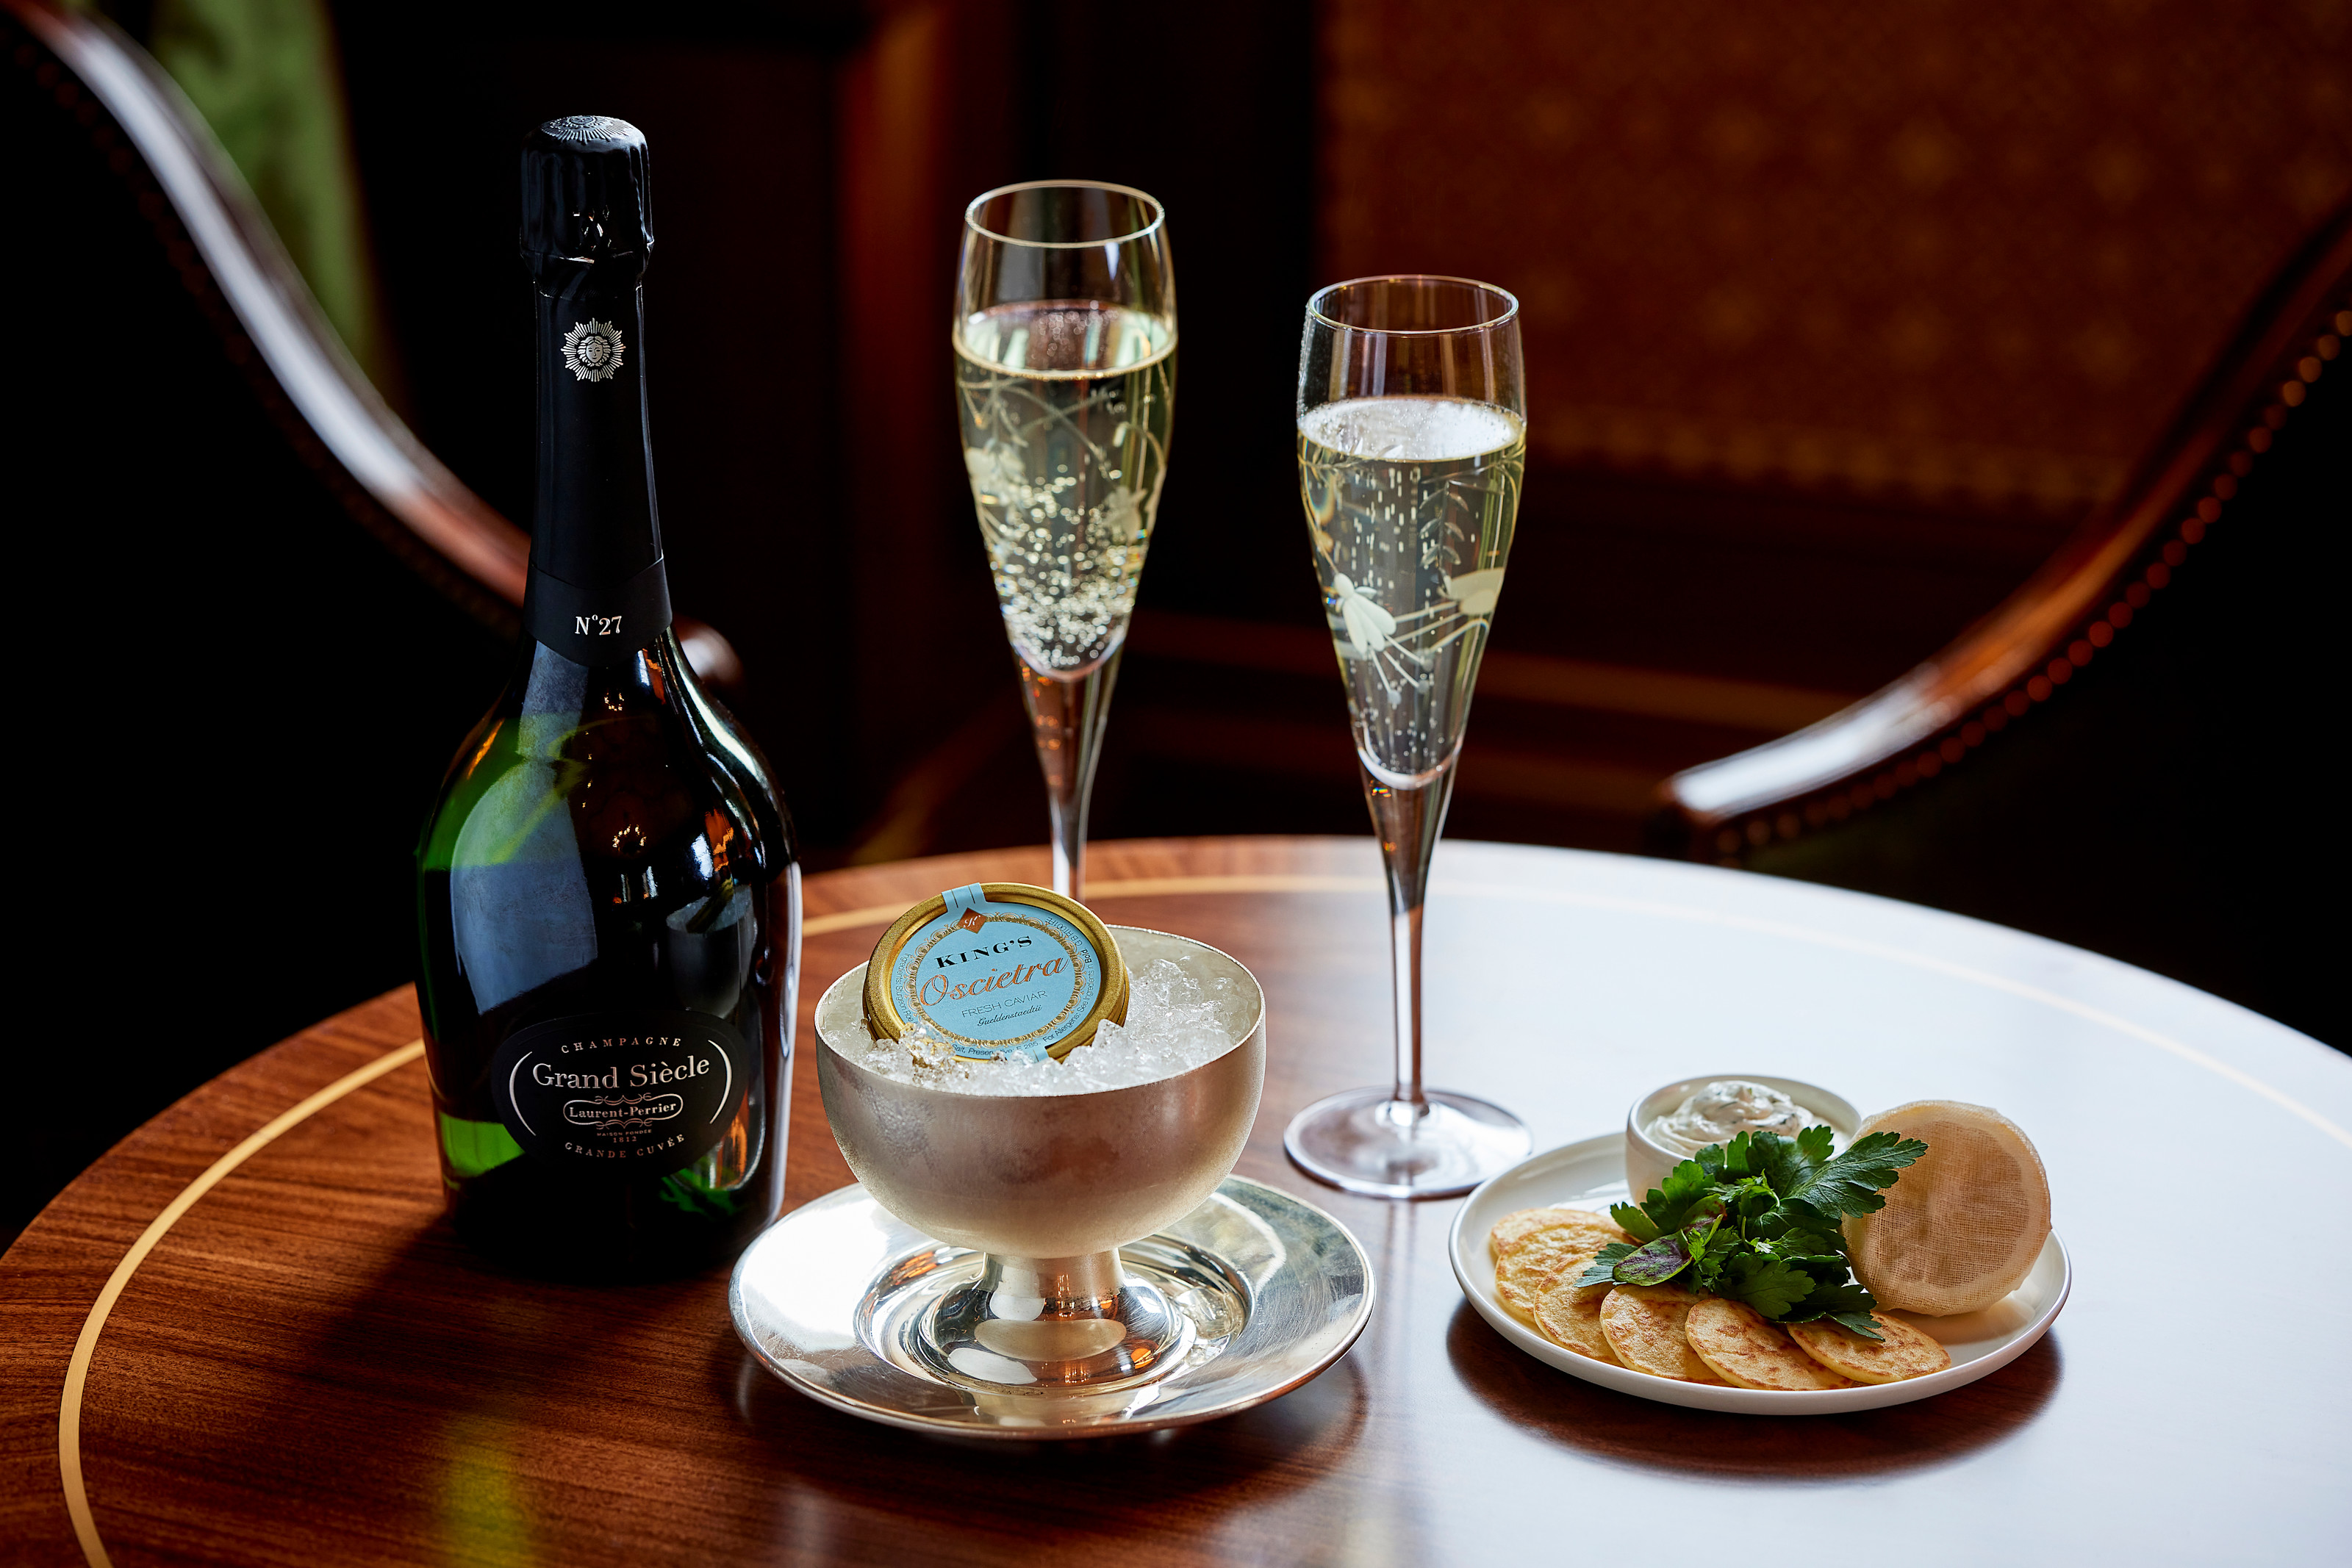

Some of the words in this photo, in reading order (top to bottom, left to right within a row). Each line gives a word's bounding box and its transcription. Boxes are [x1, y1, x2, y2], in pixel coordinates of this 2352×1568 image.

[934, 935, 1033, 969] KING'S
[1080, 947, 1092, 963] Bold.
[895, 953, 911, 985] Ingredients:
[919, 956, 1071, 1007] Oscietra
[1084, 970, 1095, 1000] Ingredients
[895, 985, 907, 1011] Sturgeon
[961, 1002, 1001, 1018] FRESH
[1005, 990, 1048, 1007] CAVIAR
[1077, 1001, 1089, 1013] See
[903, 1011, 914, 1021] Roe
[977, 1005, 1042, 1026] Gueldenstaedtii
[1055, 1013, 1081, 1037] Allergens:
[561, 1037, 682, 1054] CHAMPAGNE
[1042, 1034, 1055, 1043] For
[532, 1062, 620, 1090] Grand
[629, 1055, 711, 1087] Siècle
[569, 1101, 677, 1118] Laurent-Perrier
[564, 1142, 626, 1158] GRANDE
[637, 1134, 685, 1157] CUVÉE
